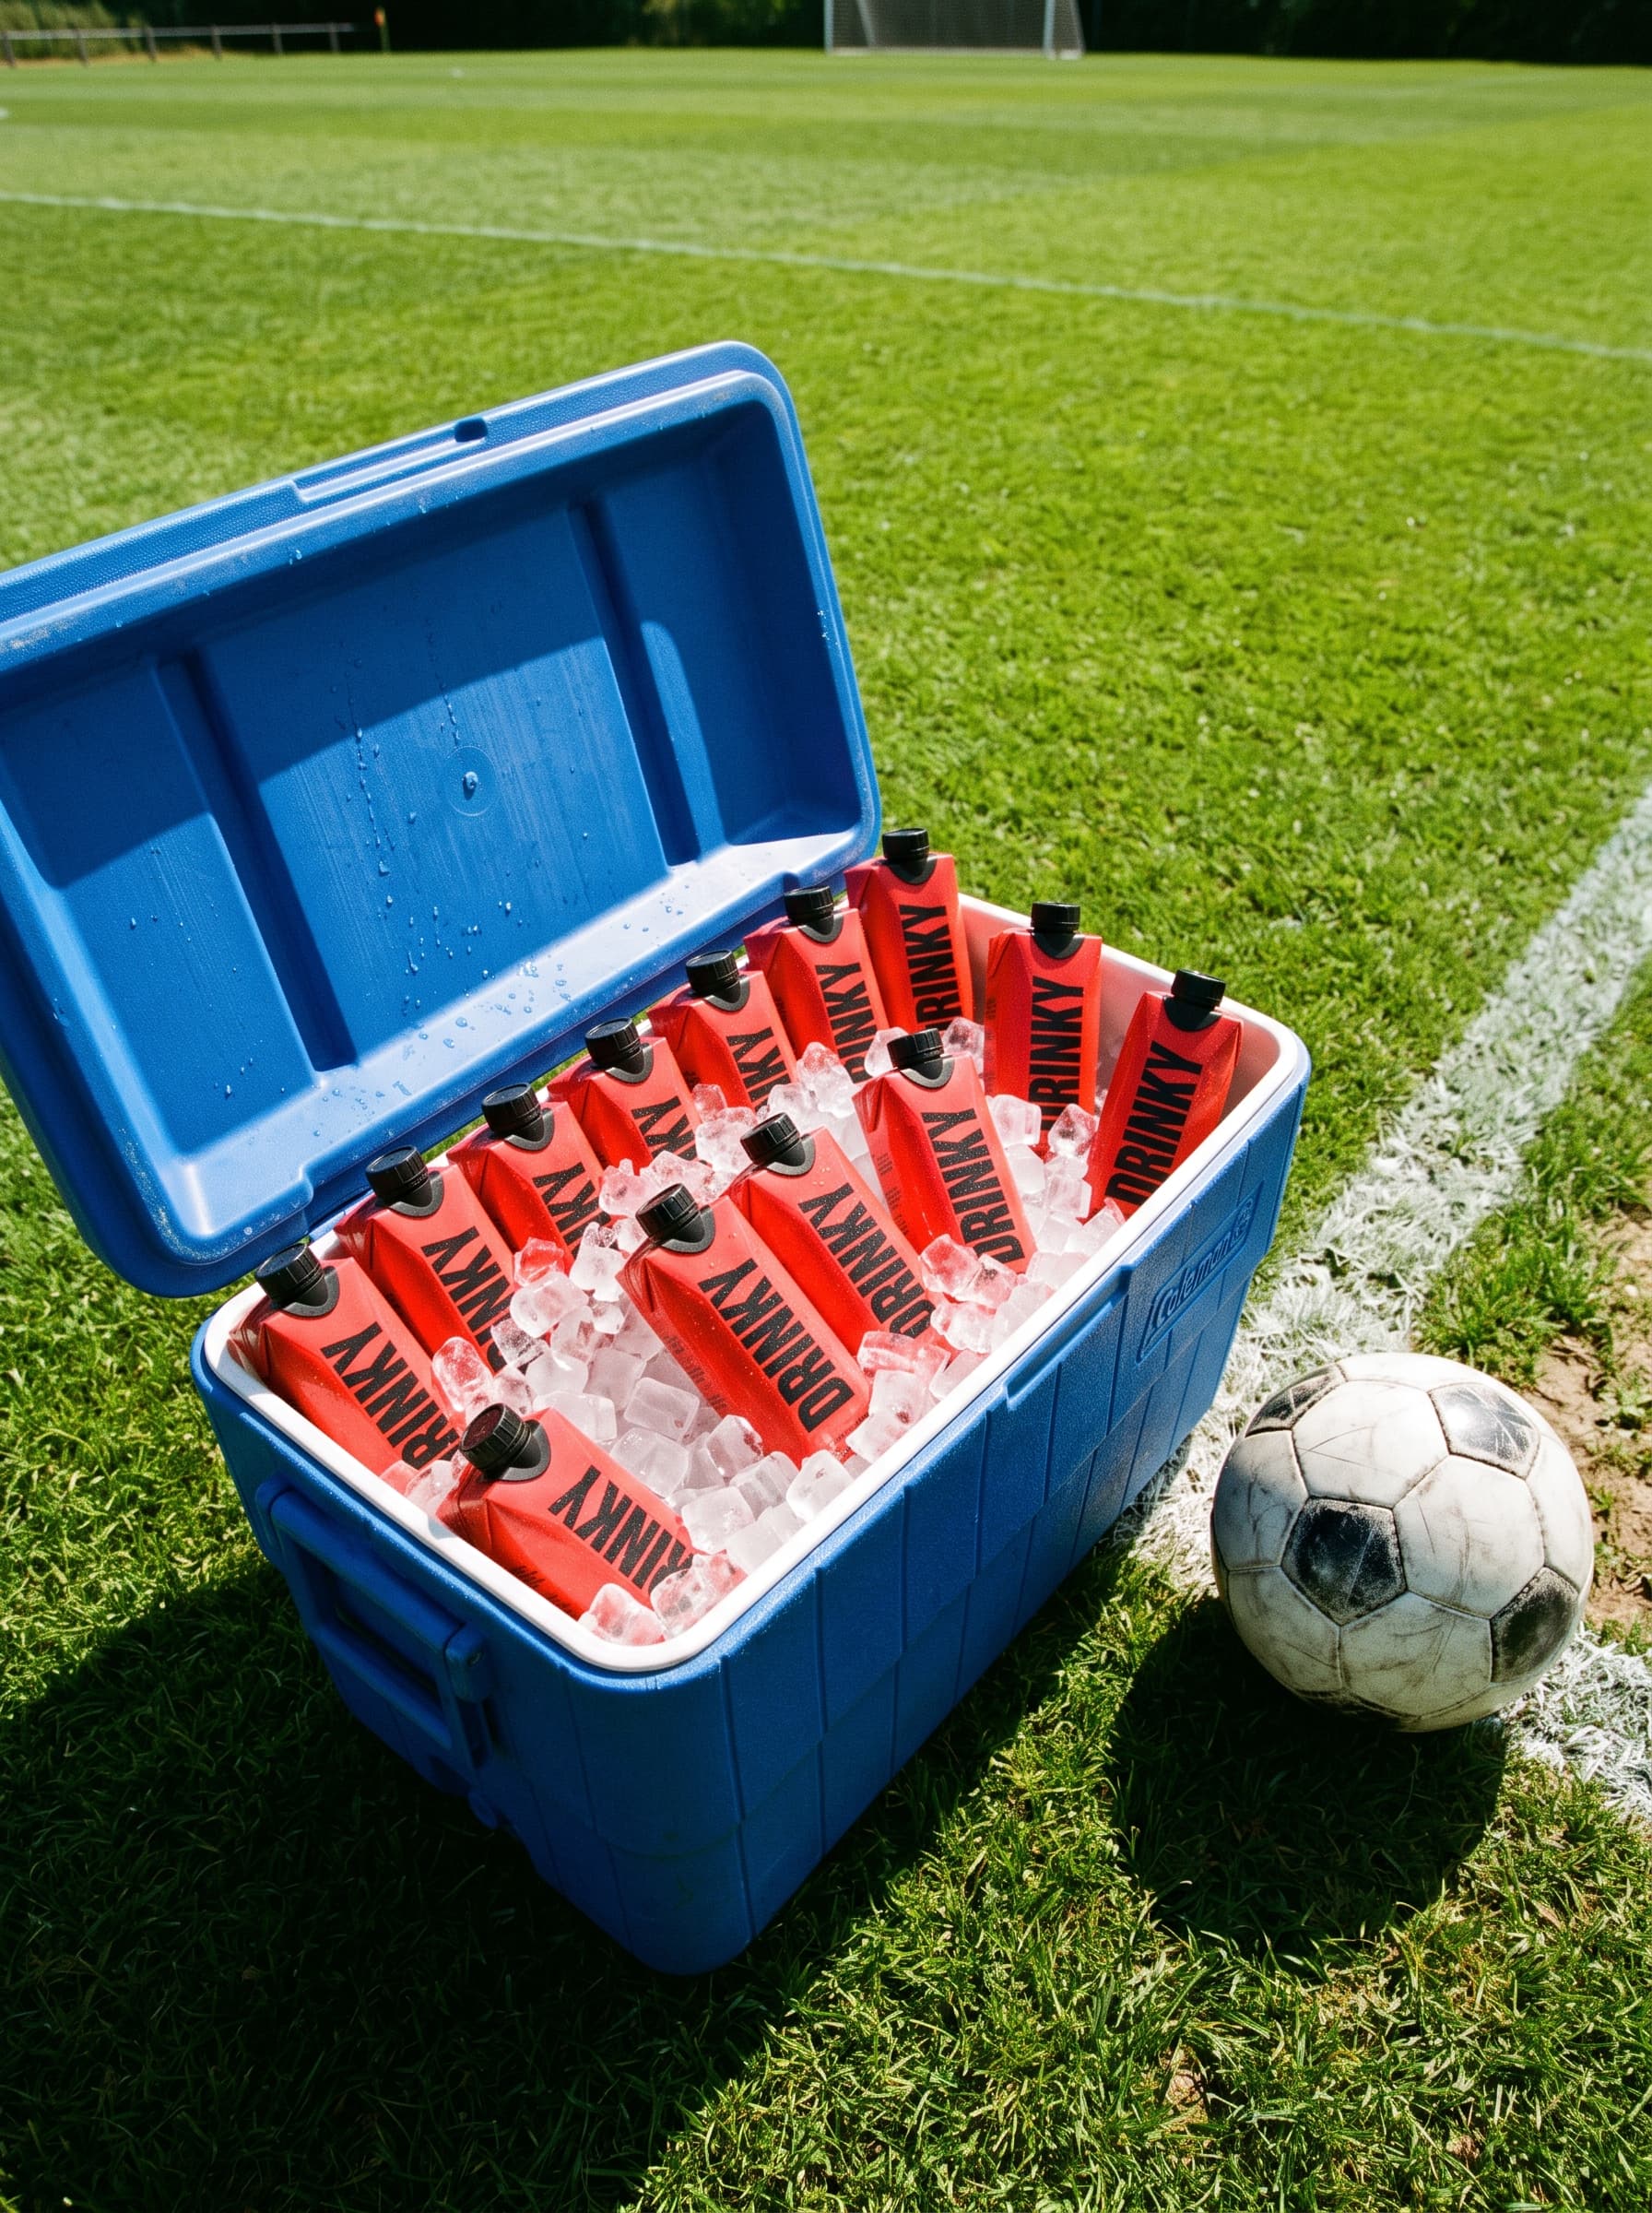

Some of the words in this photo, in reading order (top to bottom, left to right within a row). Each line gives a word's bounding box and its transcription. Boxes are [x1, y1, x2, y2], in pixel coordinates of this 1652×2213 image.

[921, 1108, 1025, 1264] DRINKY
[1104, 1040, 1203, 1206] DRINKY
[798, 1182, 936, 1339] DRINKY
[320, 1321, 460, 1470] RINKY
[697, 1258, 855, 1433] DRINKY
